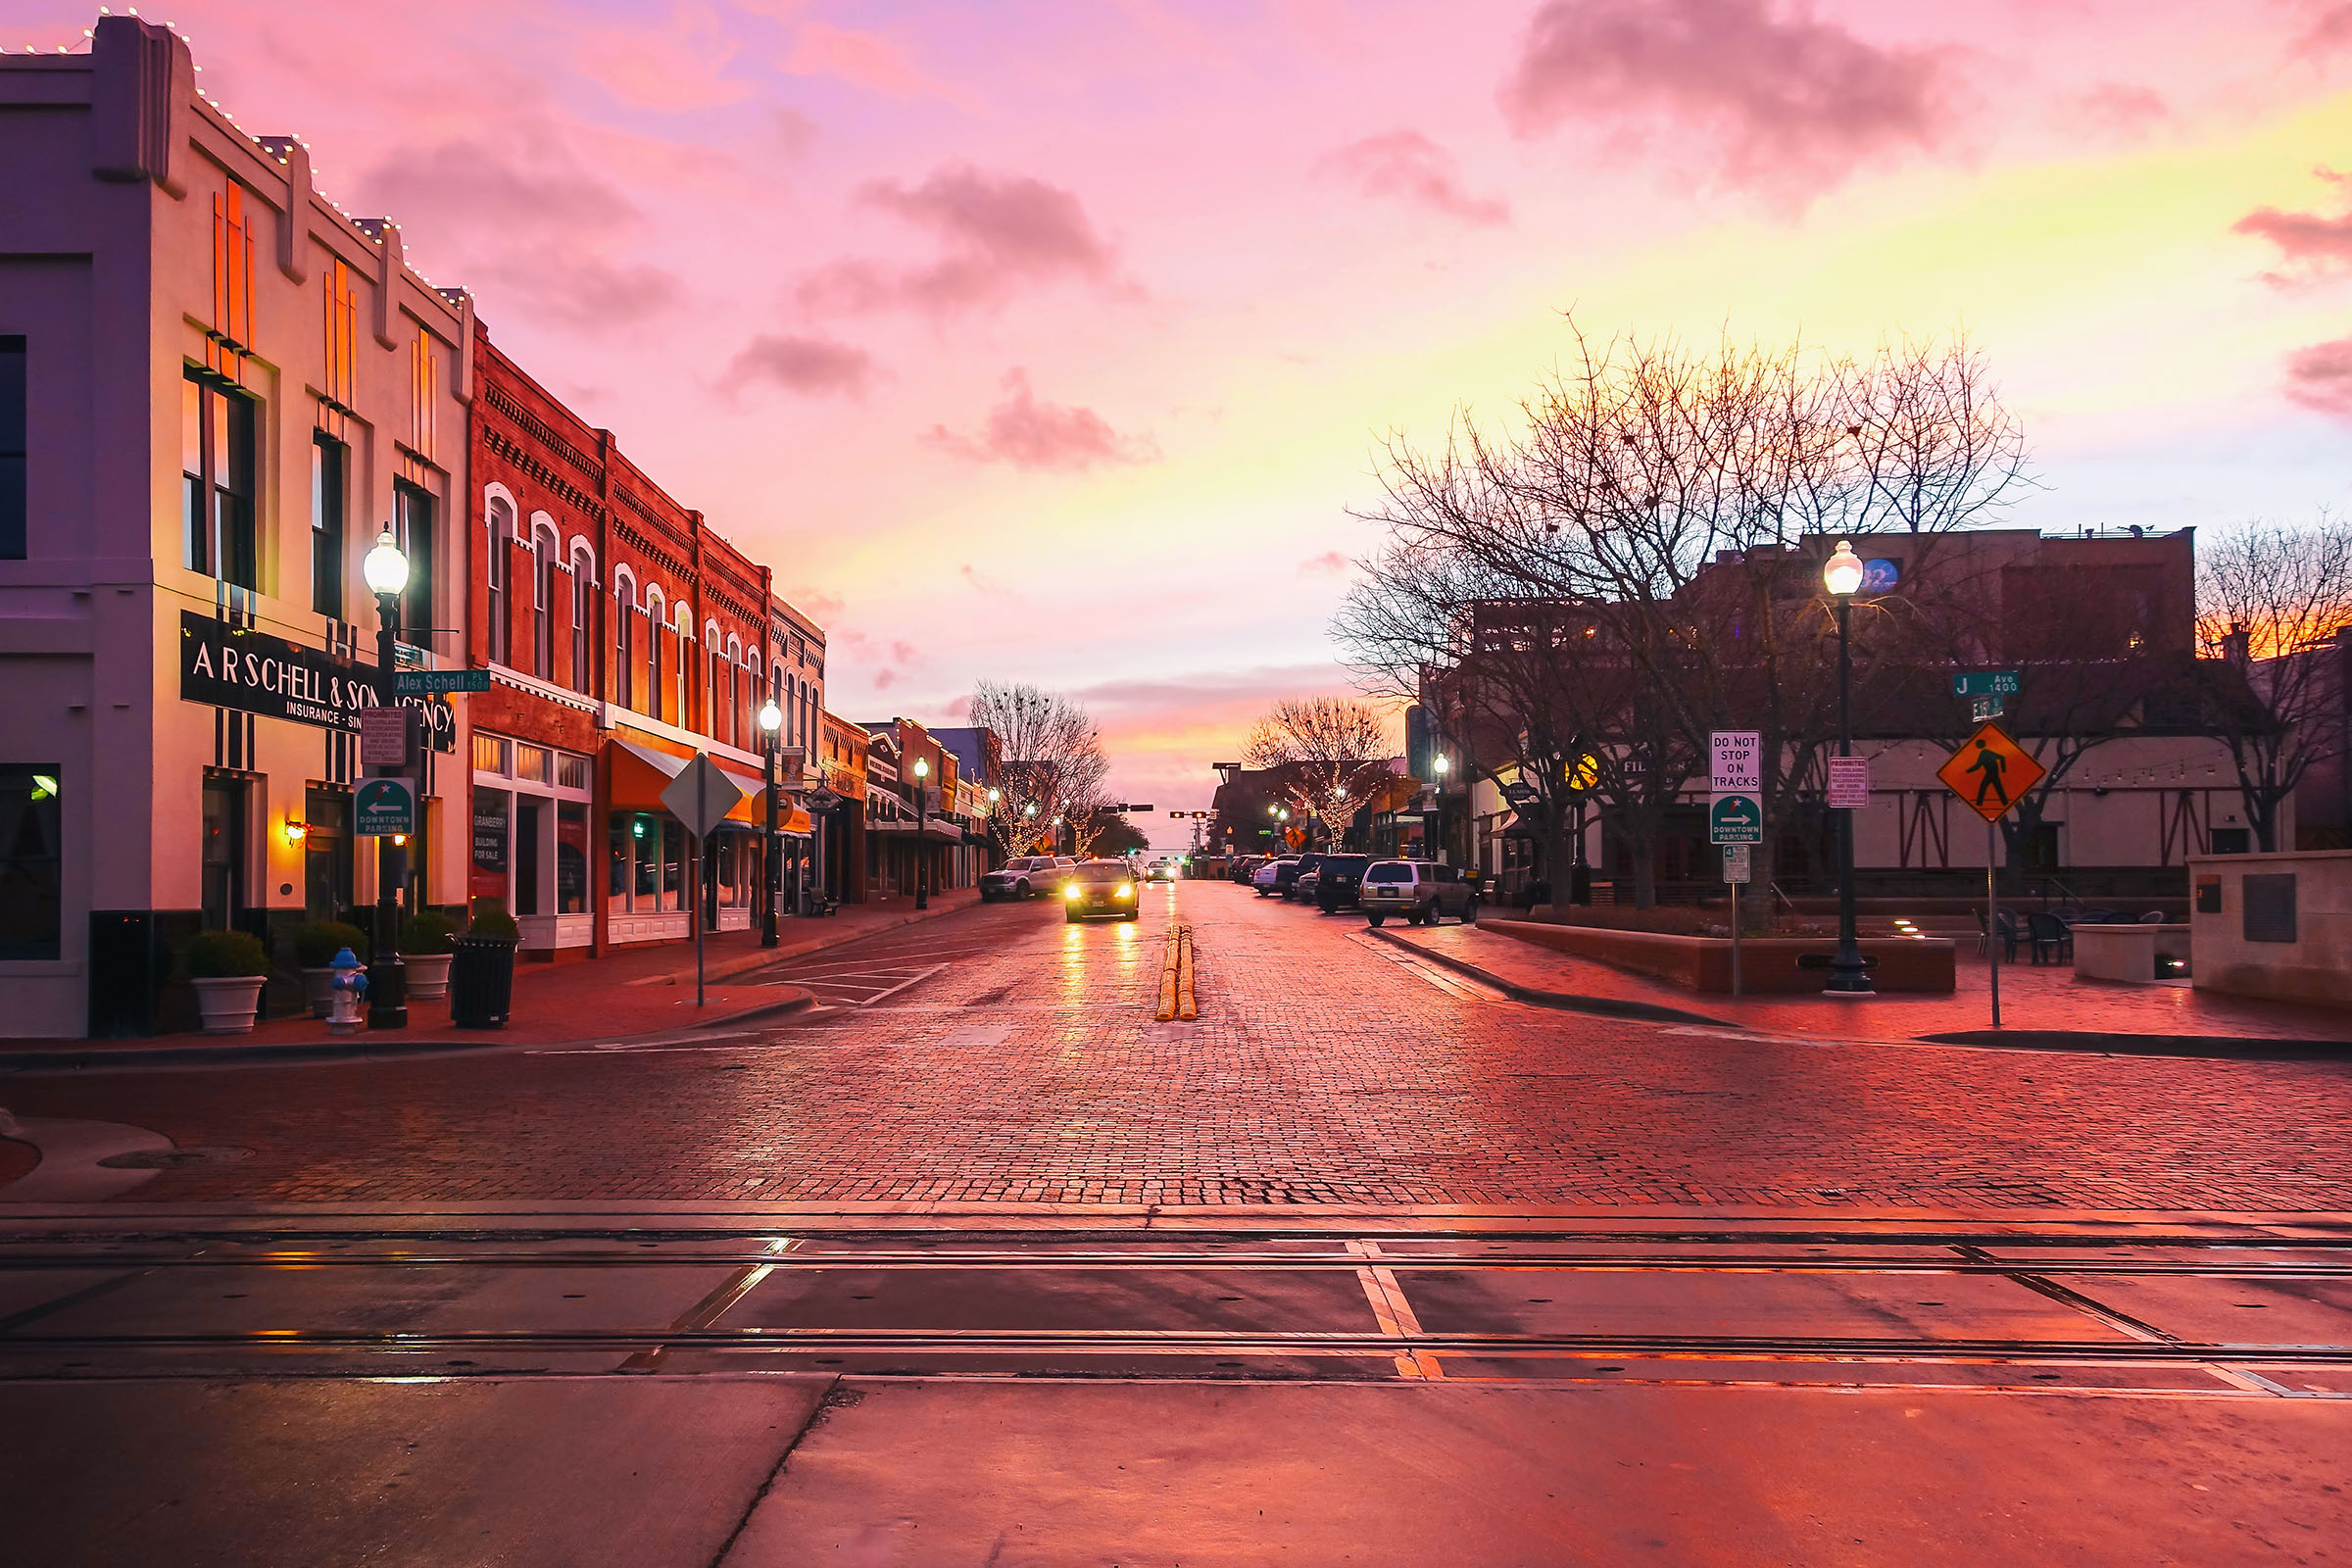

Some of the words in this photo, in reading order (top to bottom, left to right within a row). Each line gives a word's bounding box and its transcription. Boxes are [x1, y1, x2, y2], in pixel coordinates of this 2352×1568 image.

[193, 641, 215, 678] A
[222, 647, 238, 683] R
[244, 653, 326, 705] SCHELL
[330, 676, 343, 708] &
[394, 697, 454, 733] NCY
[397, 674, 422, 691] Alex
[425, 674, 465, 690] Schell
[1956, 677, 1968, 695] J
[1989, 682, 2018, 692] 1400
[286, 701, 340, 725] INSURANCE
[1714, 737, 1730, 748] DO
[1734, 736, 1756, 748] NOT
[1721, 751, 1750, 760] STOP
[1727, 763, 1744, 773] ON
[1713, 776, 1758, 787] TRACKS
[475, 849, 485, 858] FOR
[486, 850, 498, 860] SALE
